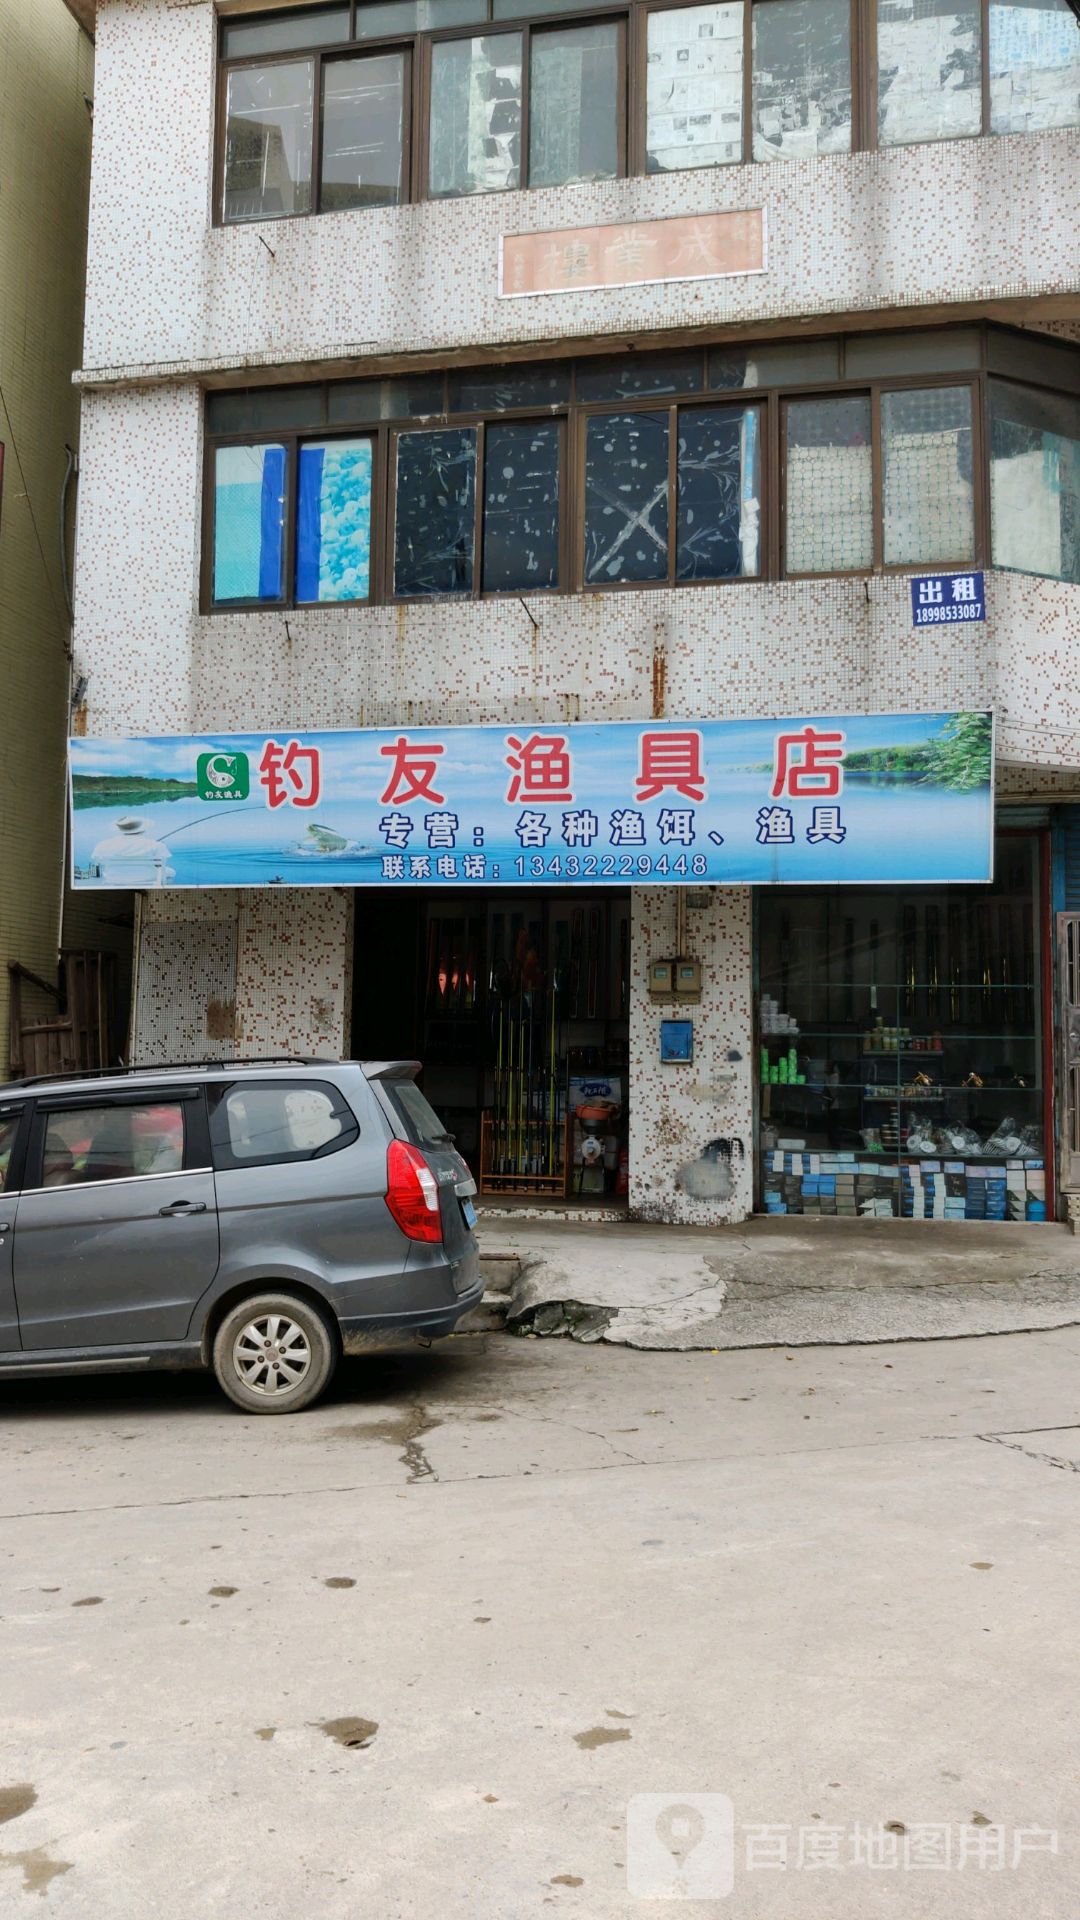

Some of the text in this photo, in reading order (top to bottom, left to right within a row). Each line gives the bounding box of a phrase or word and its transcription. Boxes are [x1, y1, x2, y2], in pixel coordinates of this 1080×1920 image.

[919, 577, 977, 604] 出租
[916, 603, 982, 623] 18998533087
[258, 726, 847, 809] 钓友渔具店
